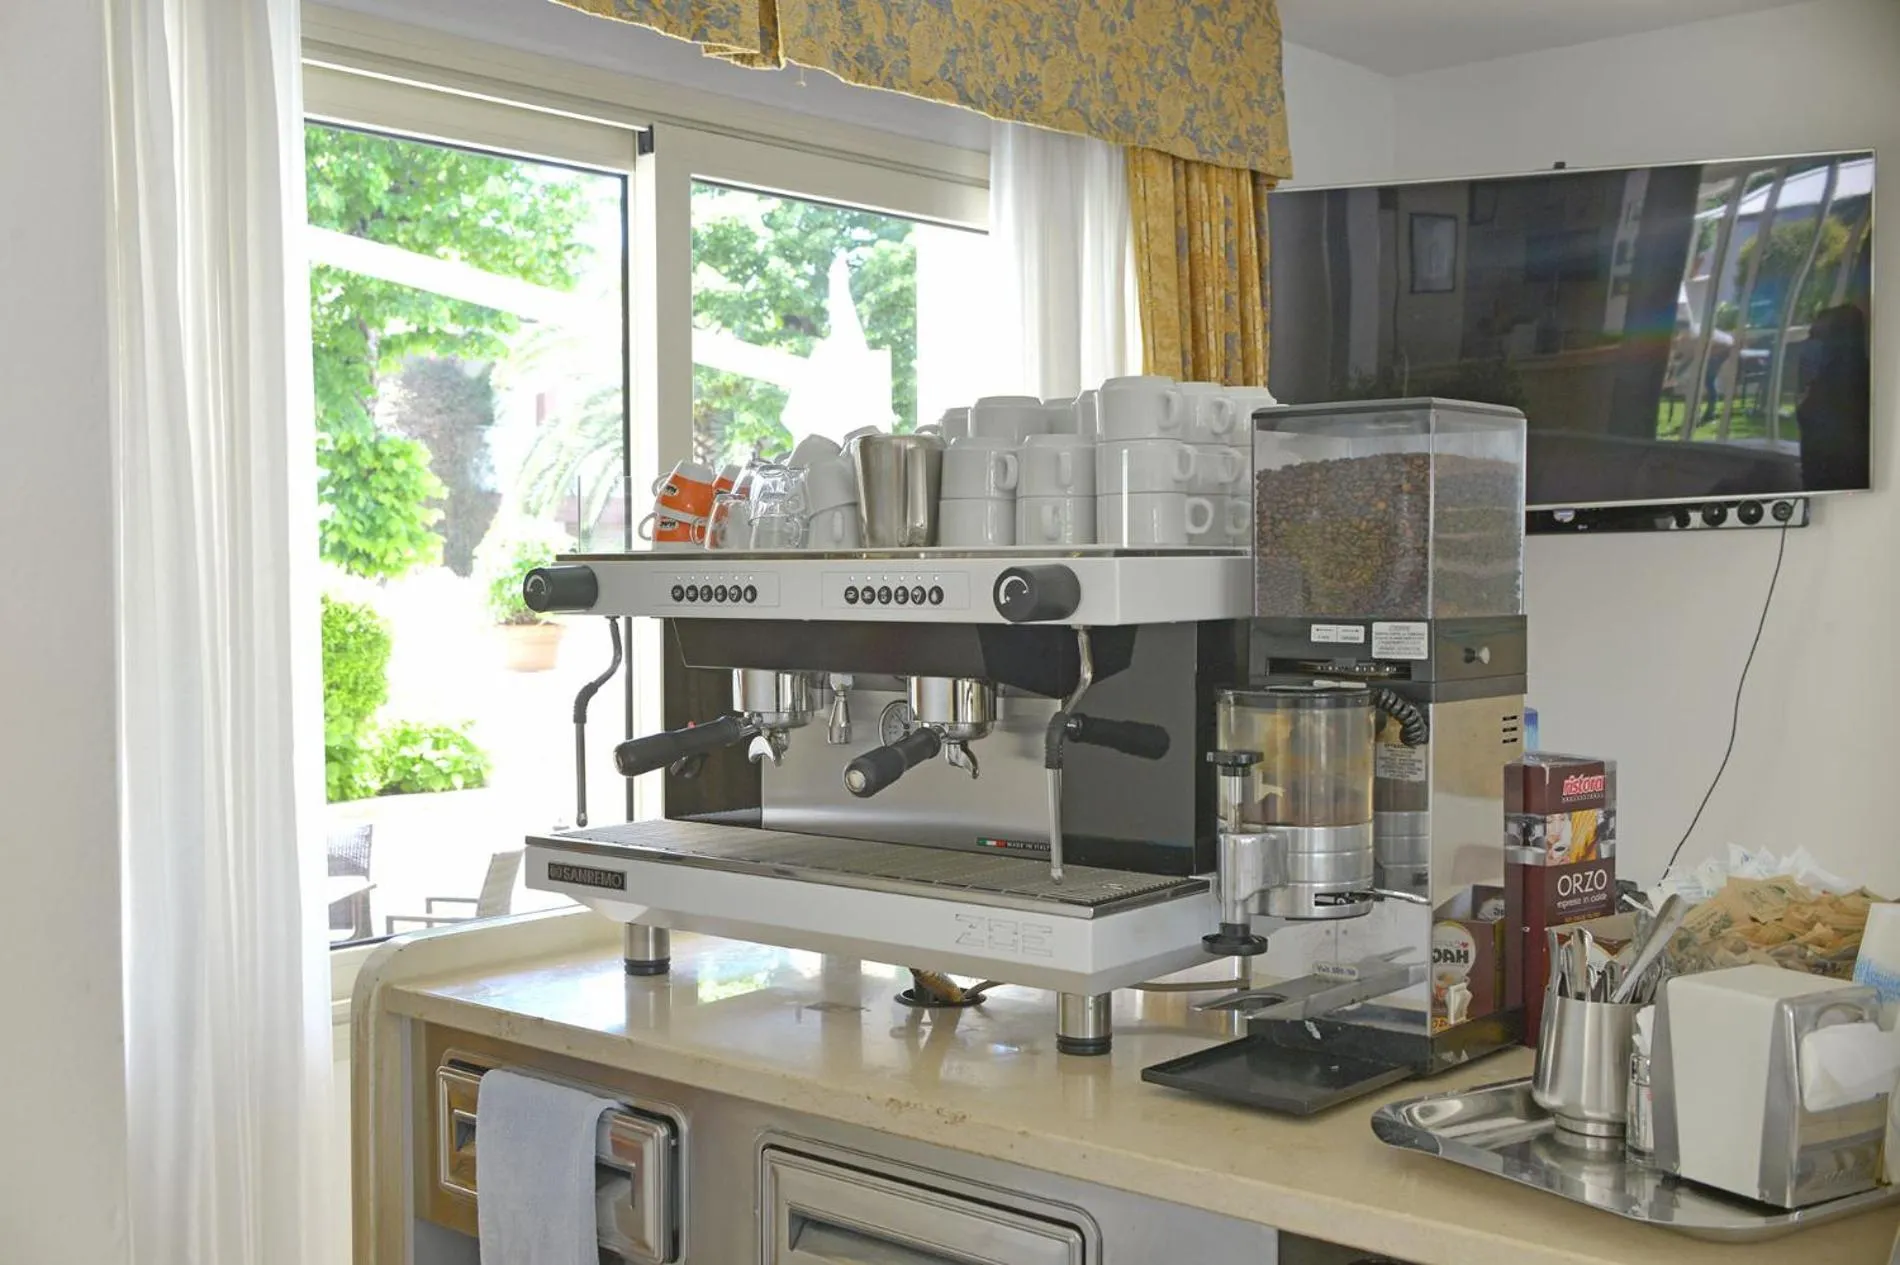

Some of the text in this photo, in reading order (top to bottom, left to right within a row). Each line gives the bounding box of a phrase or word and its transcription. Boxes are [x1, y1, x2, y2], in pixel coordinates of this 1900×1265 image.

[1562, 774, 1604, 796] ristora
[562, 866, 623, 889] SANREMO
[1557, 869, 1607, 897] ORZO
